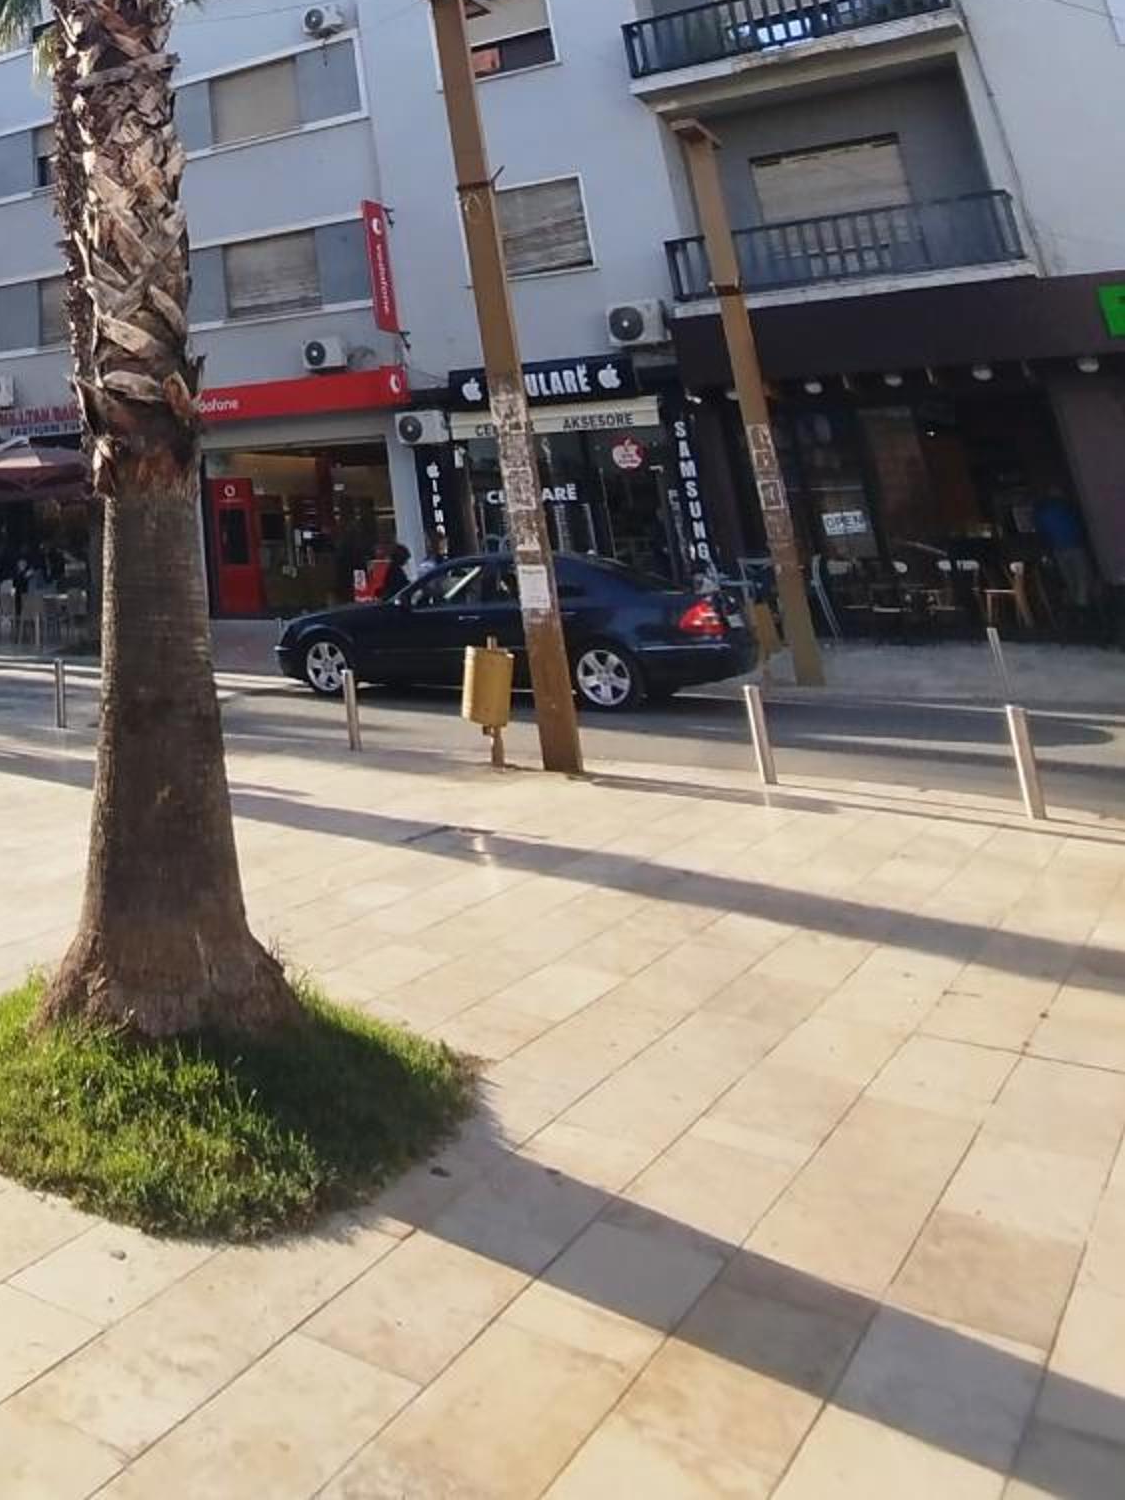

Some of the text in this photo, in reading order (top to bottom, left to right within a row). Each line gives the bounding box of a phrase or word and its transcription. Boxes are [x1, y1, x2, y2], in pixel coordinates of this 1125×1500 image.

[523, 364, 592, 398] ULARË
[563, 412, 635, 430] AKSESORE
[674, 421, 711, 560] SAMSUNG
[825, 514, 866, 529] OPEN
